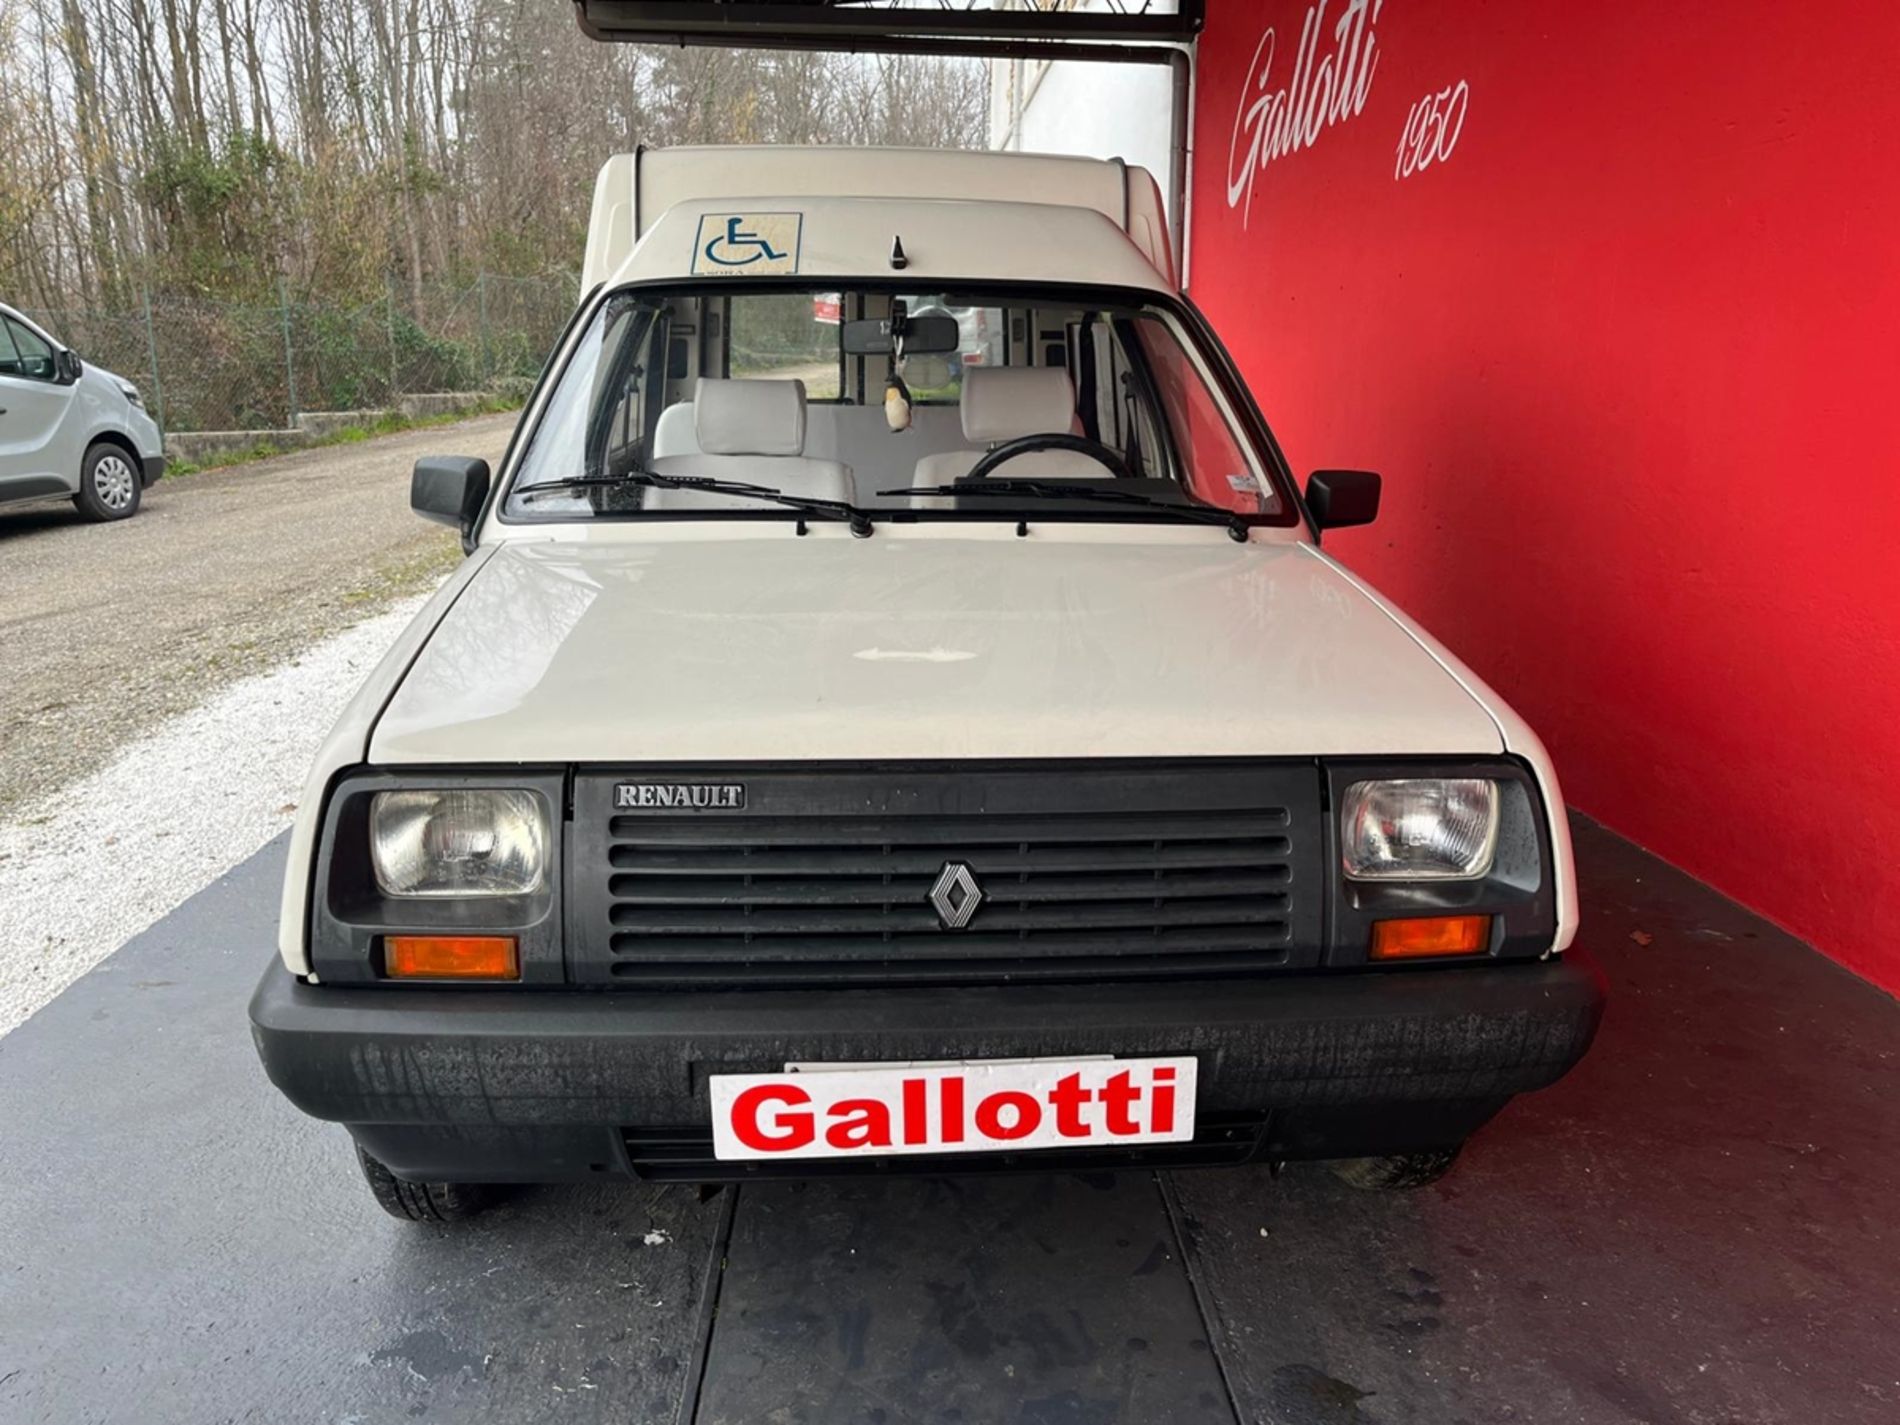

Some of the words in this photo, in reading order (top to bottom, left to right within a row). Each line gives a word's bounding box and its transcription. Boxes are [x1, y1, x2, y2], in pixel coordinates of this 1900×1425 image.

[1227, 0, 1383, 231] Gallotti
[1395, 79, 1469, 180] 1950
[617, 785, 742, 807] RENAULT
[730, 1067, 1177, 1153] Gallotti
